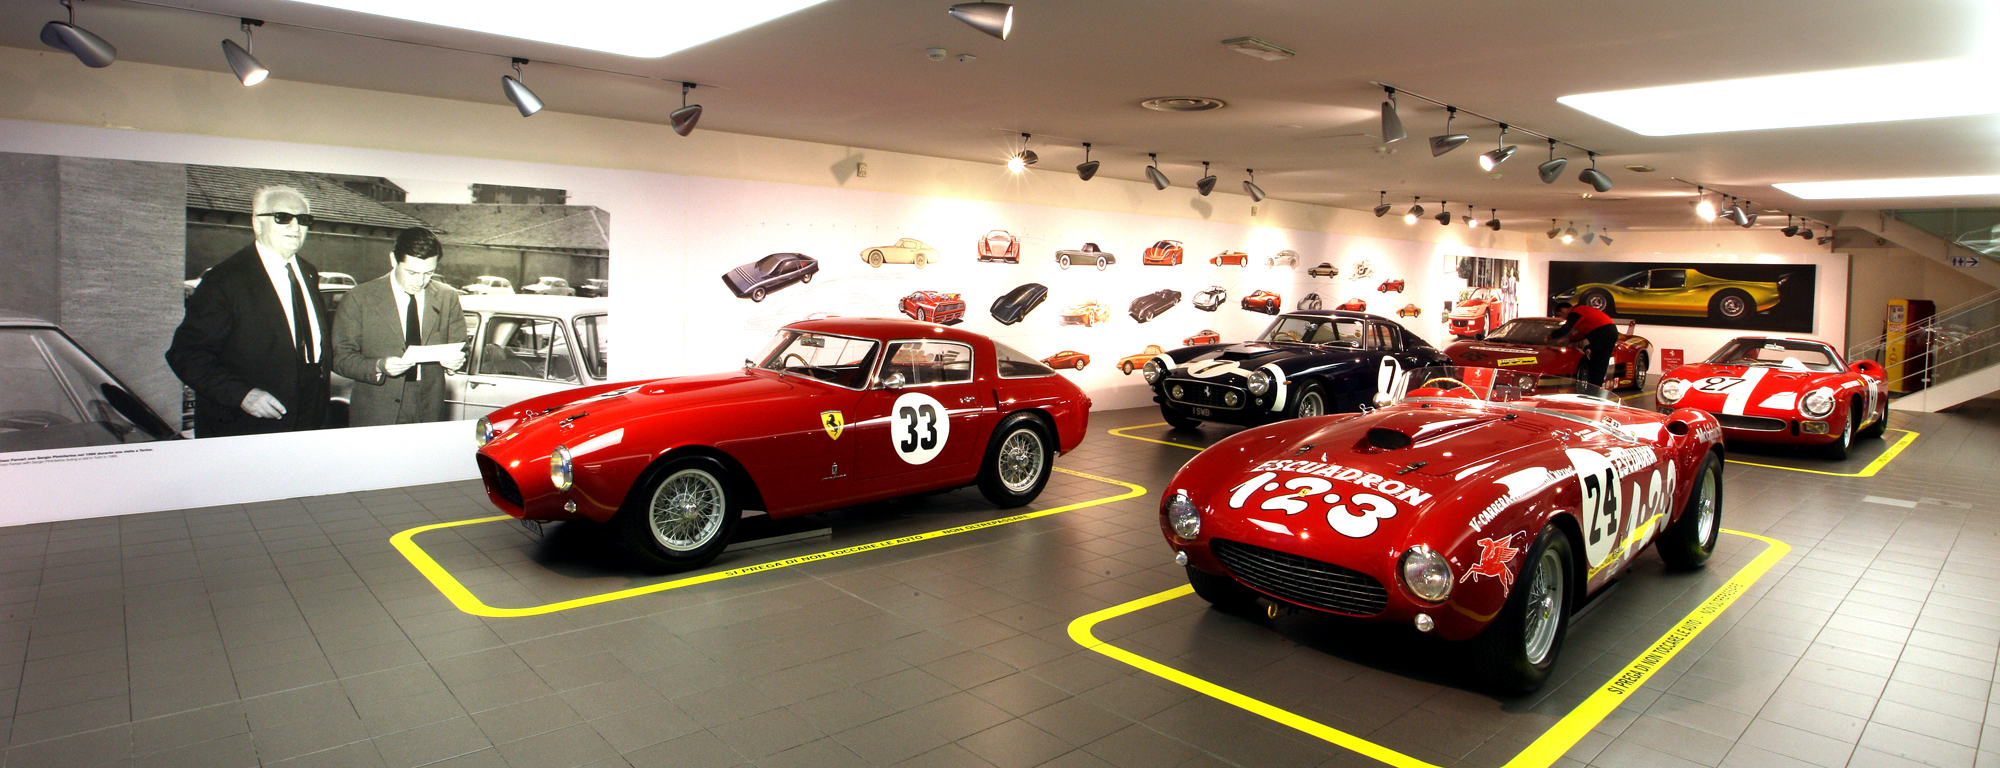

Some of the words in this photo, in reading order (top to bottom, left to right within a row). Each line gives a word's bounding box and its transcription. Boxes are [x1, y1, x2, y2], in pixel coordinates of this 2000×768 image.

[1383, 359, 1397, 395] 7
[1699, 377, 1747, 391] 27
[899, 404, 938, 453] 33
[1250, 460, 1433, 507] ESCUADRON
[1583, 467, 1618, 546] 24
[741, 562, 783, 573] PREGA
[800, 553, 827, 562] NON
[830, 542, 877, 556] TOCCARE
[879, 539, 895, 547] LE
[896, 535, 923, 544] AUTO
[1674, 629, 1691, 637] LE
[1681, 619, 1702, 632] AUTO
[1652, 634, 1685, 656] TOCCARE
[1634, 663, 1651, 672] DI
[1641, 653, 1664, 667] NON
[1614, 669, 1645, 692] PREGA
